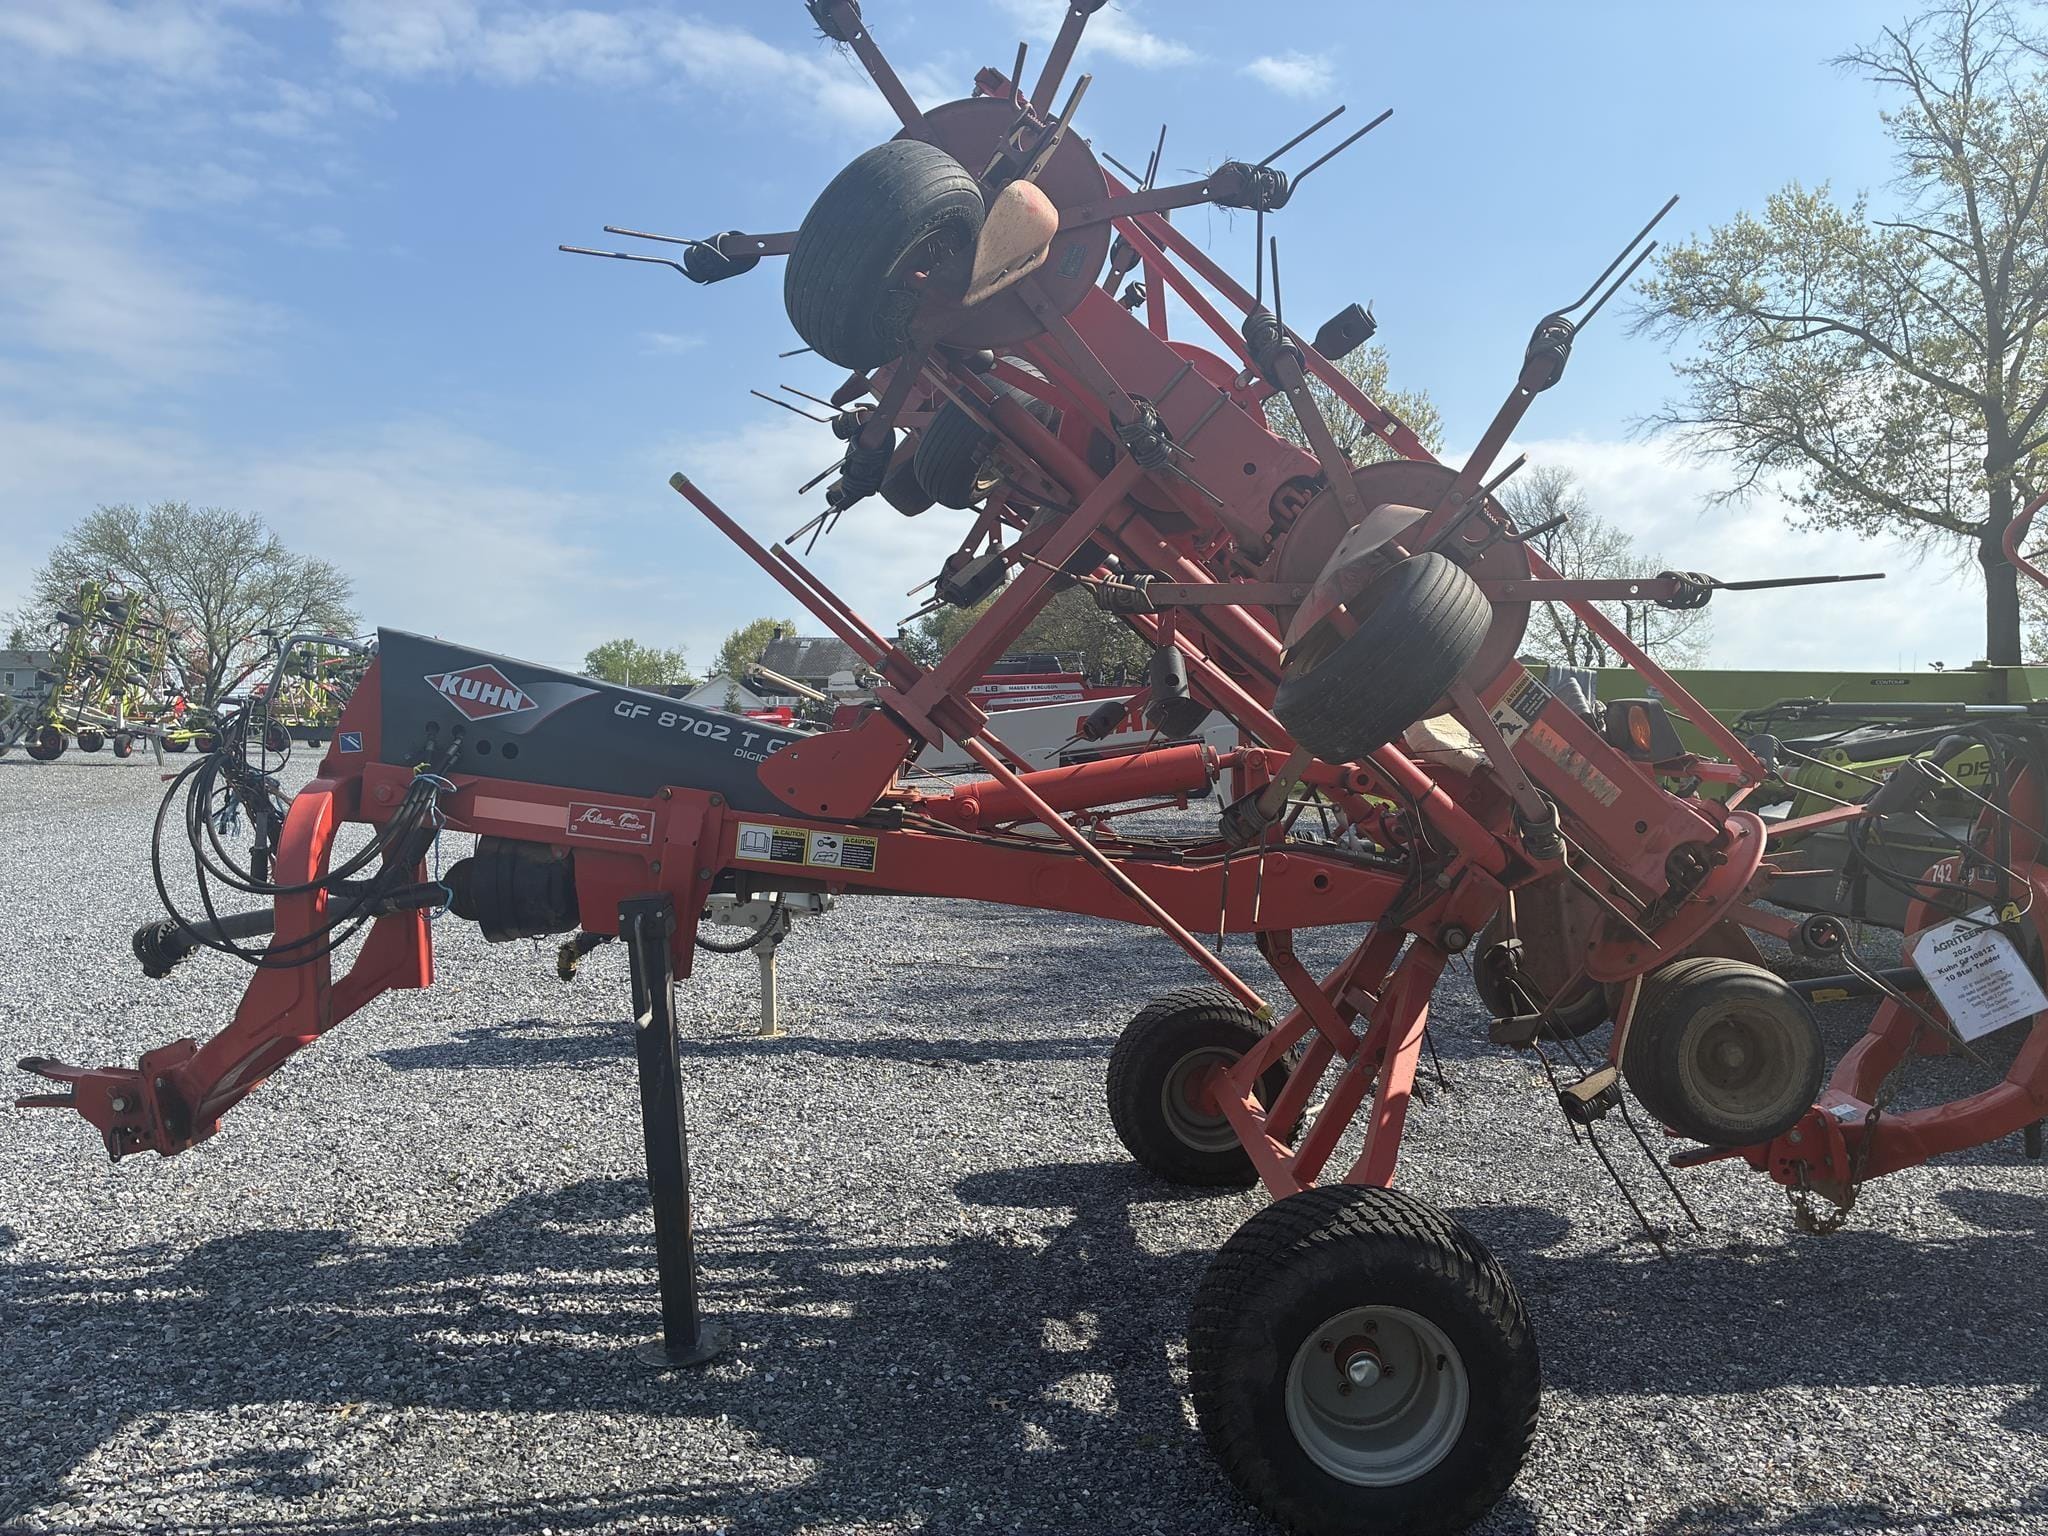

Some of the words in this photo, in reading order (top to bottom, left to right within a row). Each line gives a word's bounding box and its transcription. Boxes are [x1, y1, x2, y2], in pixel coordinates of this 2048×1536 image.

[439, 674, 523, 711] KUHN
[614, 700, 651, 719] GF
[657, 711, 731, 742] 8702
[741, 731, 760, 747] T
[766, 738, 793, 754] G
[780, 829, 805, 838] CAUTION
[850, 837, 875, 846] CAUTION
[1932, 864, 1952, 883] 742
[1953, 945, 1973, 957] 2022
[1937, 963, 1958, 975] Kuhn
[1945, 974, 1956, 982] 10
[1957, 966, 1973, 978] Star
[1974, 954, 2001, 969] Tedder
